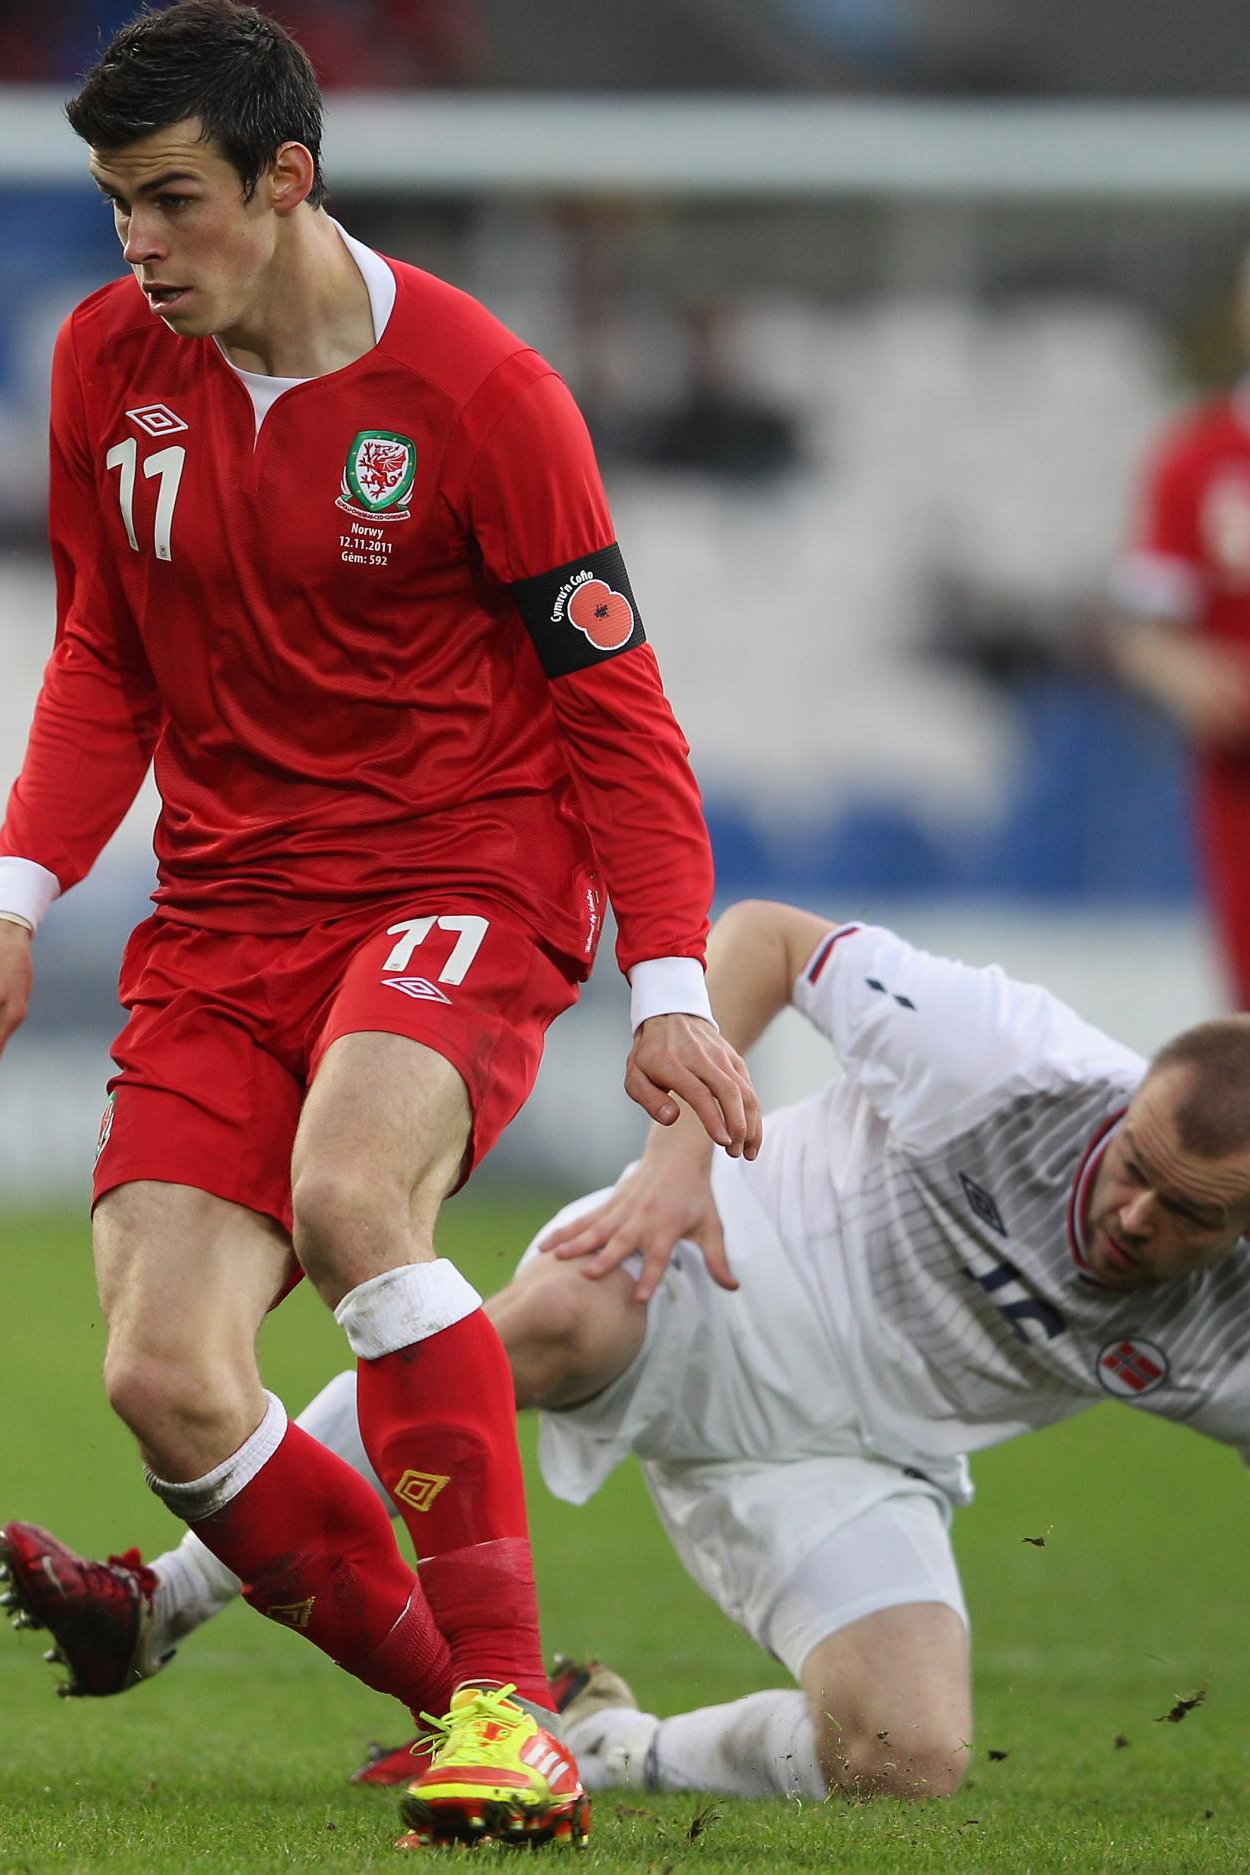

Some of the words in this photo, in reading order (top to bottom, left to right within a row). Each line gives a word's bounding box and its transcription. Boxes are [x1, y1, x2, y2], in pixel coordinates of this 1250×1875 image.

[106, 438, 186, 561] 11
[351, 522, 383, 540] Norwy
[339, 536, 392, 553] 12.11.2011
[369, 555, 387, 566] 592
[570, 570, 593, 586] Cofio
[382, 916, 489, 986] 11
